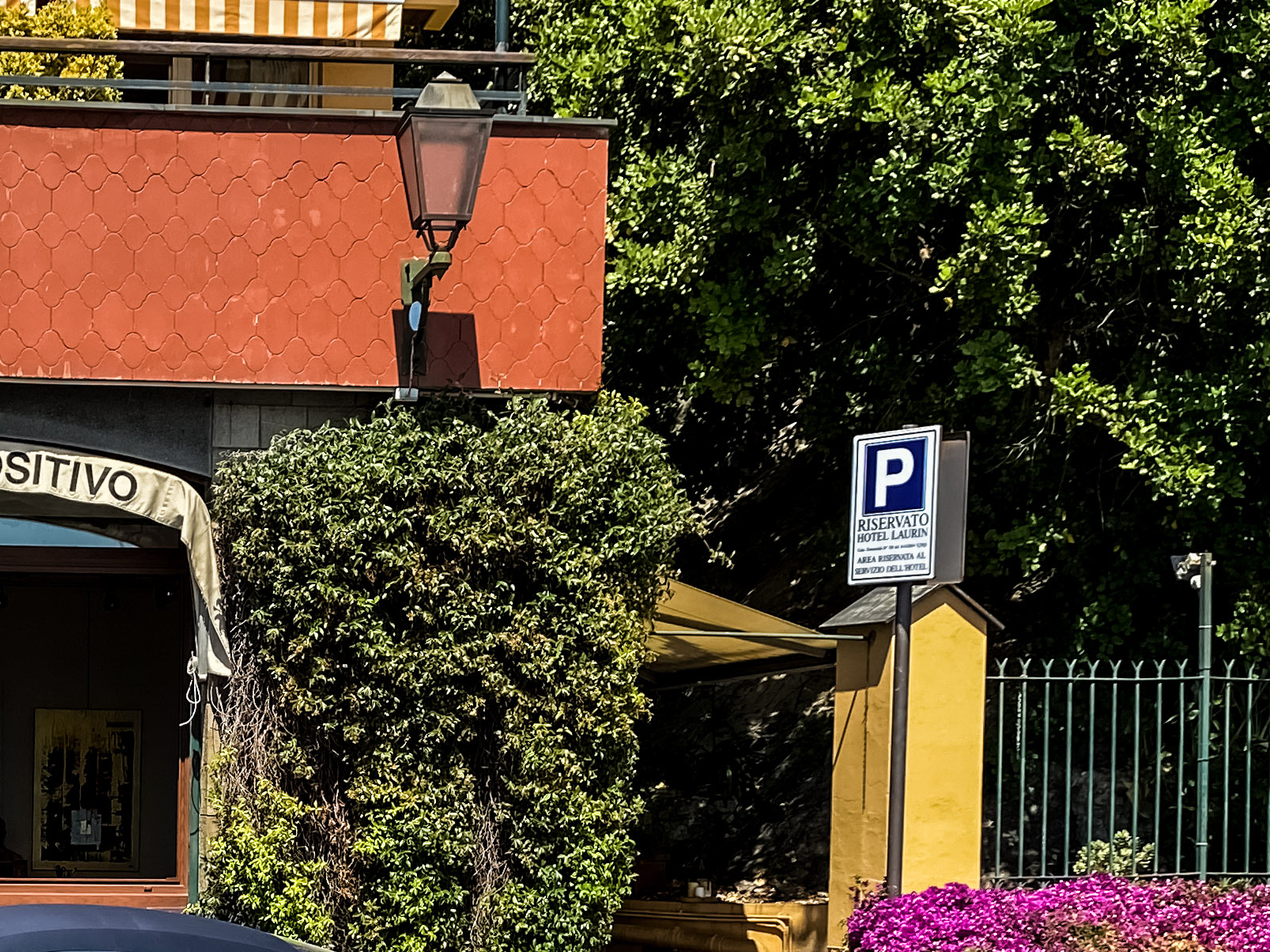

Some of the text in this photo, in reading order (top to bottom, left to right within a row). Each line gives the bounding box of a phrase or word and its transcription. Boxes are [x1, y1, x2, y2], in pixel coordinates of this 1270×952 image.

[874, 447, 915, 508] P
[857, 513, 929, 532] RISERVATO
[857, 527, 928, 543] HOTEL LAURIN
[857, 552, 926, 564] AREA RISERVATA AL
[854, 566, 885, 575] SERVIZIO
